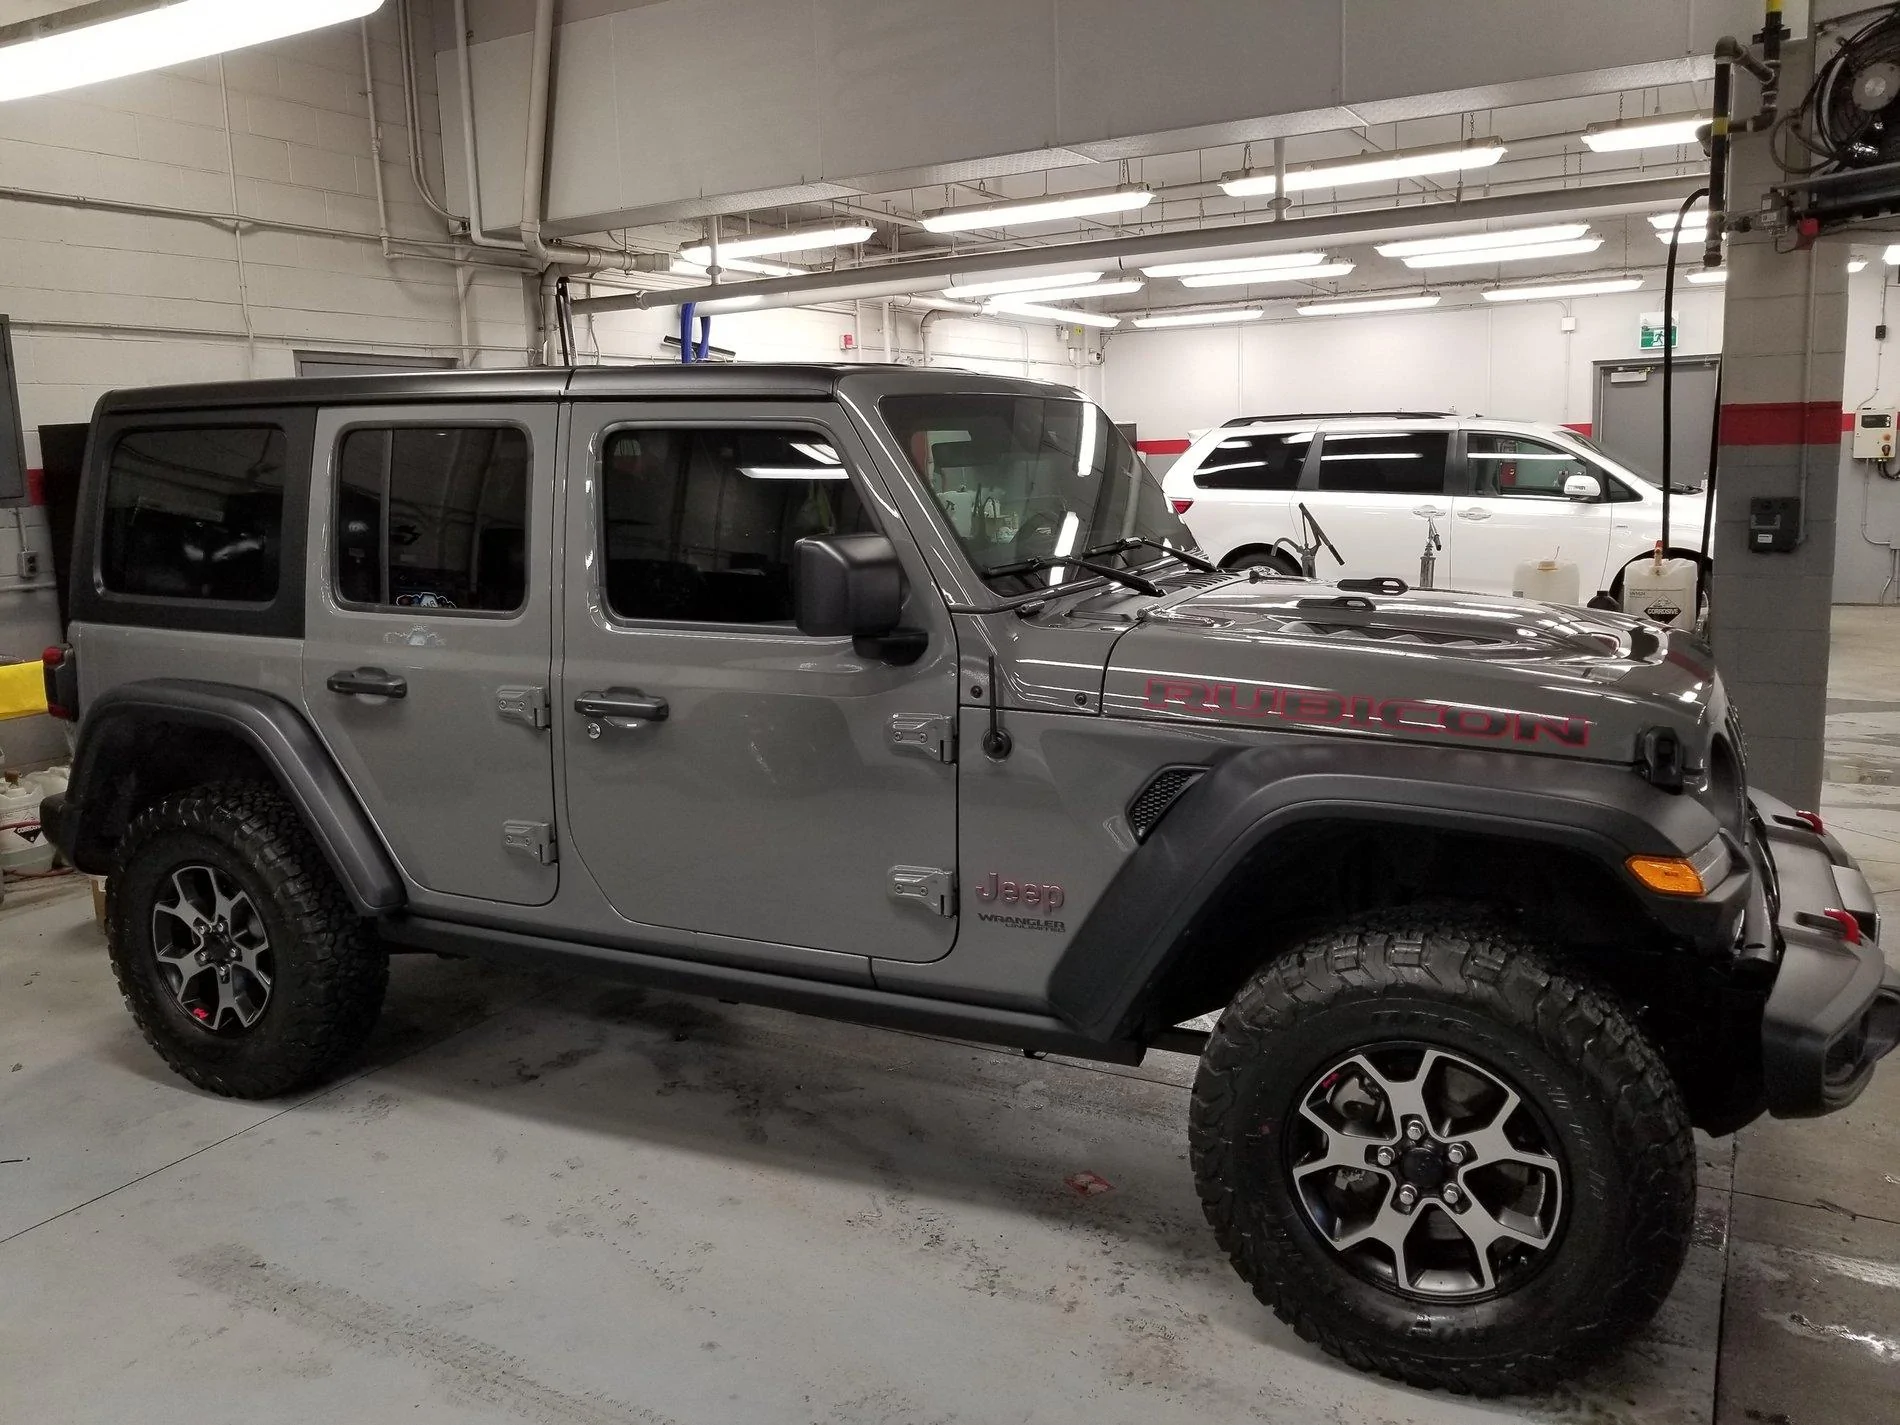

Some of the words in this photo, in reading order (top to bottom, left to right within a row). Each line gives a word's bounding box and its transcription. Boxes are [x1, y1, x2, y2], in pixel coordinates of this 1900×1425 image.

[1144, 677, 1590, 748] RUBICON
[975, 871, 1065, 916] Jeep
[978, 912, 1065, 929] WRANGLER
